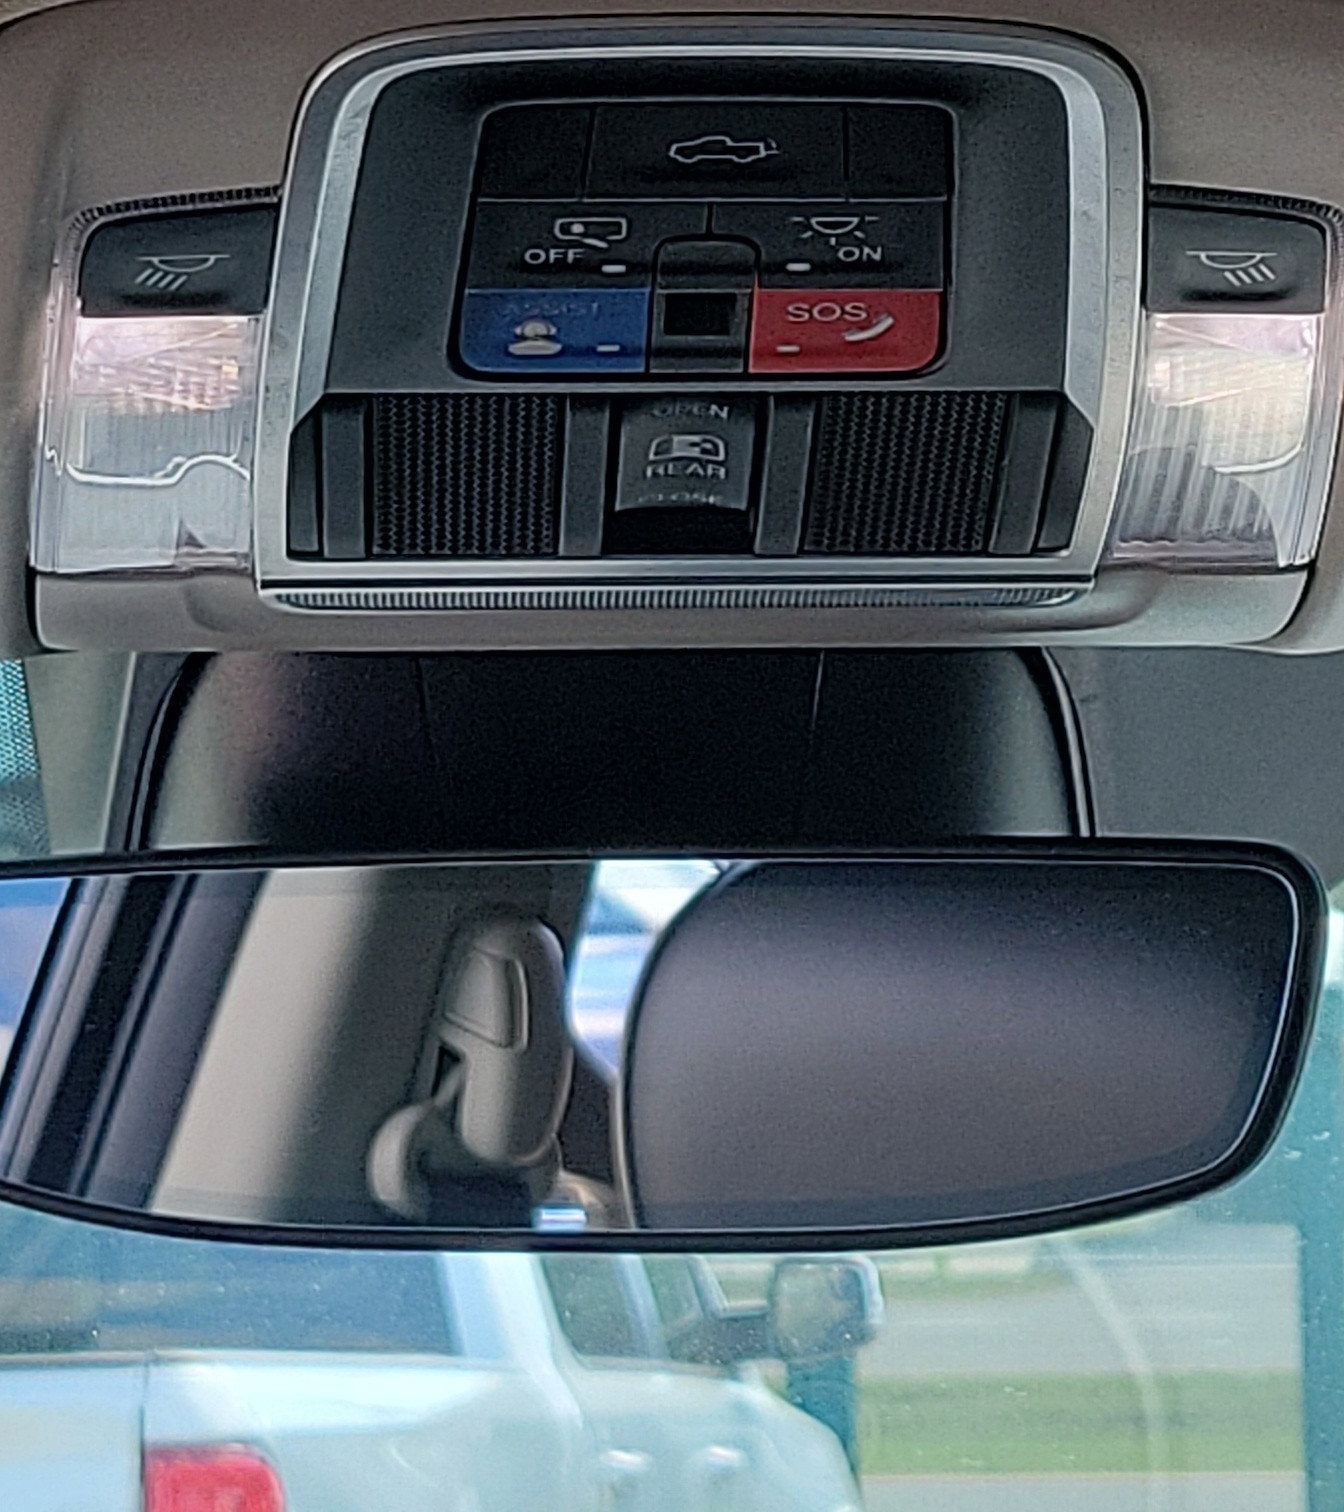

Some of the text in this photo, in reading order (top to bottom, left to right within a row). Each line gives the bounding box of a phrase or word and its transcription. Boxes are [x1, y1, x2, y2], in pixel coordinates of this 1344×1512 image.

[523, 248, 586, 265] OFF
[837, 245, 883, 262] ON
[786, 302, 868, 322] SOS
[652, 399, 729, 419] OPEN
[645, 461, 726, 480] REAR
